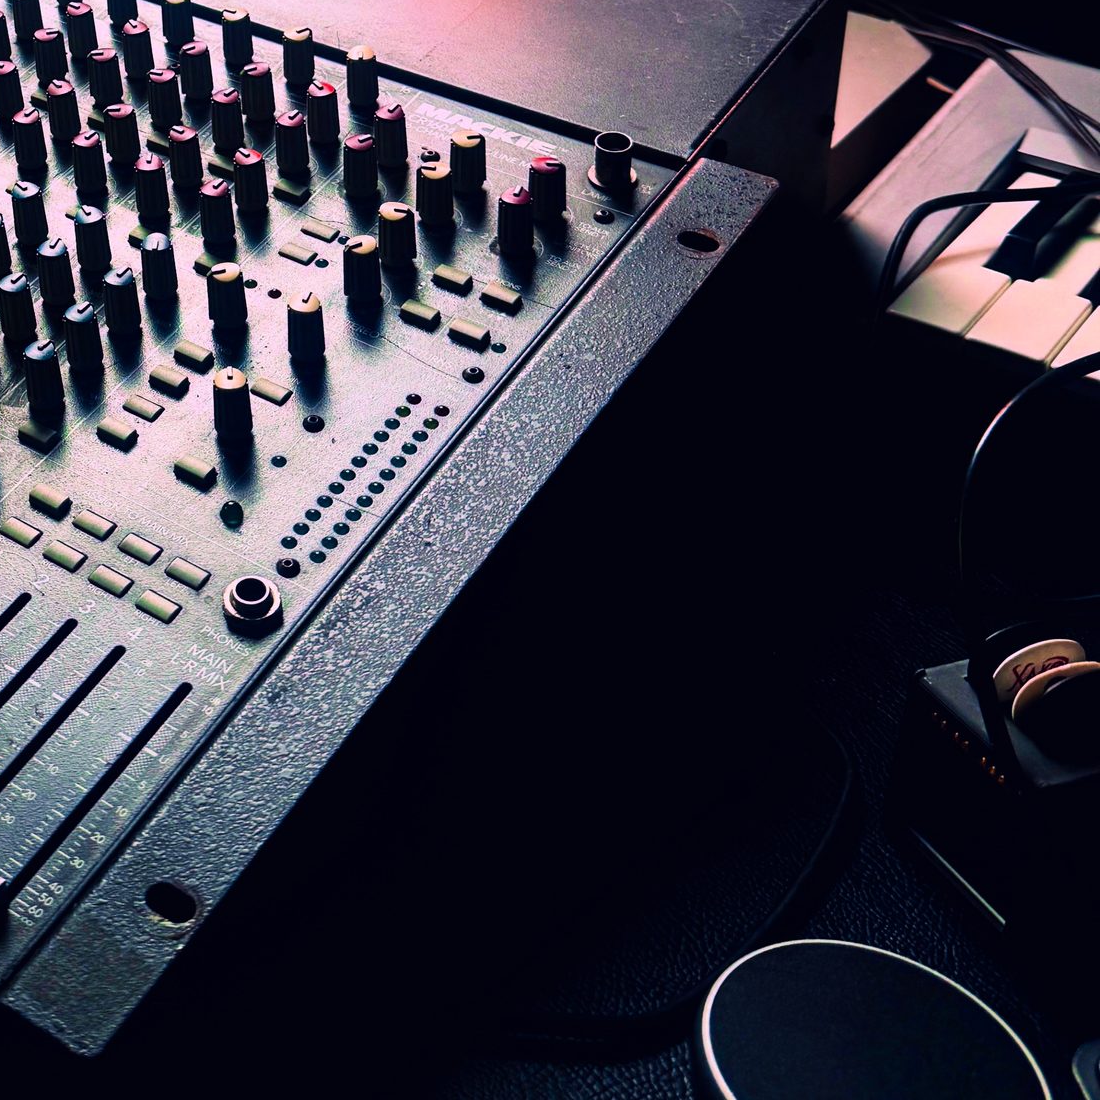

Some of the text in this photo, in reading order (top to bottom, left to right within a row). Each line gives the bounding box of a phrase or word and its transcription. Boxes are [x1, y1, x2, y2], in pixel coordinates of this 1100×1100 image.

[414, 102, 558, 156] MACKIE
[34, 574, 50, 590] 2
[78, 599, 96, 614] 3
[126, 626, 143, 642] 4
[201, 625, 250, 657] PHONES
[186, 643, 234, 675] MAIN
[170, 652, 231, 692] L-R MIX
[48, 763, 60, 774] 10
[138, 781, 147, 790] 5
[21, 788, 37, 801] 20
[1, 811, 16, 825] 30
[115, 805, 128, 817] 10
[90, 831, 106, 845] 20
[69, 856, 85, 869] 30
[49, 882, 64, 895] 40
[37, 892, 54, 907] 50
[27, 904, 44, 918] 60
